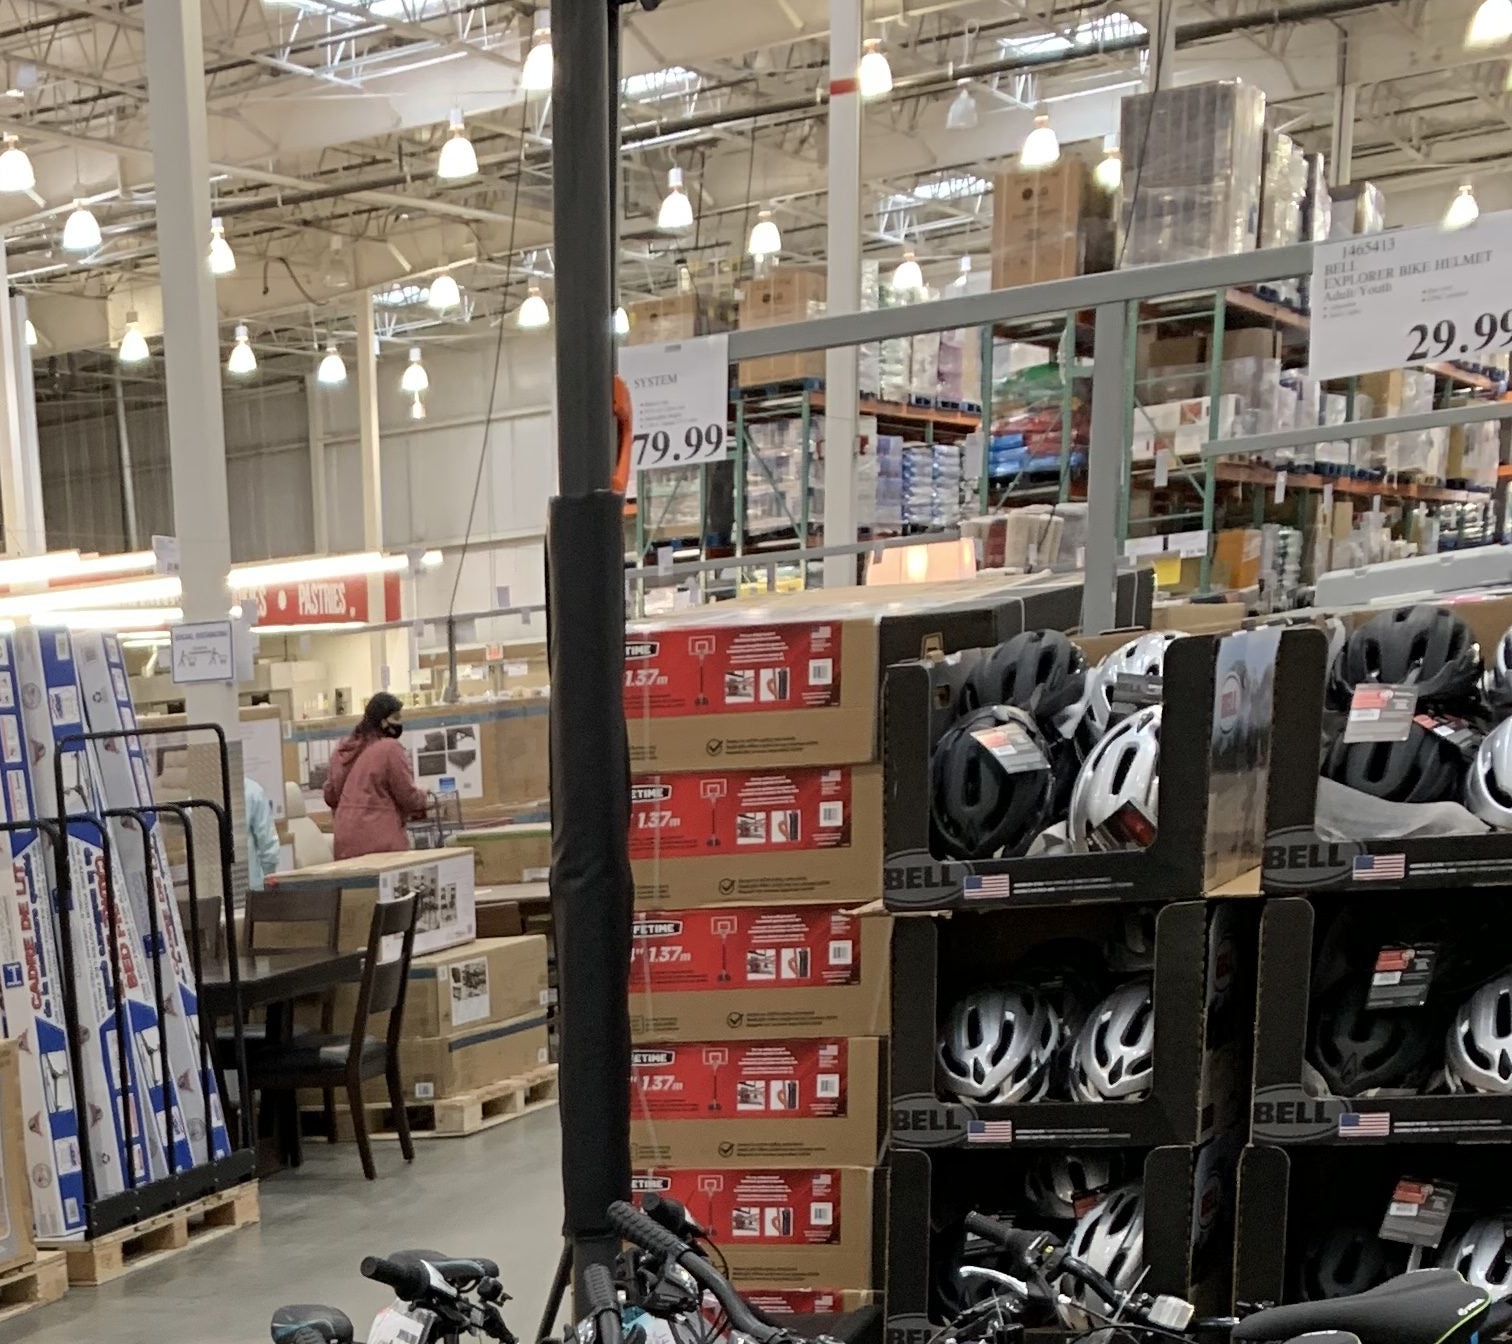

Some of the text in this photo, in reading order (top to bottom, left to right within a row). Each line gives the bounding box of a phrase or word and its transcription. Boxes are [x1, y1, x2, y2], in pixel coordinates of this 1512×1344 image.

[1324, 250, 1493, 290] EXPLORER BIKE HELMET
[1405, 308, 1512, 362] 29.99
[633, 373, 678, 389] SYSTEM
[298, 582, 347, 617] PASTRIES
[632, 787, 665, 800] ETIME
[638, 811, 681, 828] 1.37m
[1265, 842, 1346, 870] BELL
[885, 865, 957, 891] BELL
[633, 922, 676, 935] FETIME
[648, 945, 691, 963] 1.37m
[23, 935, 42, 1011] CADRE
[633, 1052, 668, 1064] ETIME
[642, 1075, 683, 1091] 1.37m
[893, 1109, 962, 1131] BELL
[1253, 1100, 1333, 1124] BELL
[632, 1178, 665, 1190] ETIME
